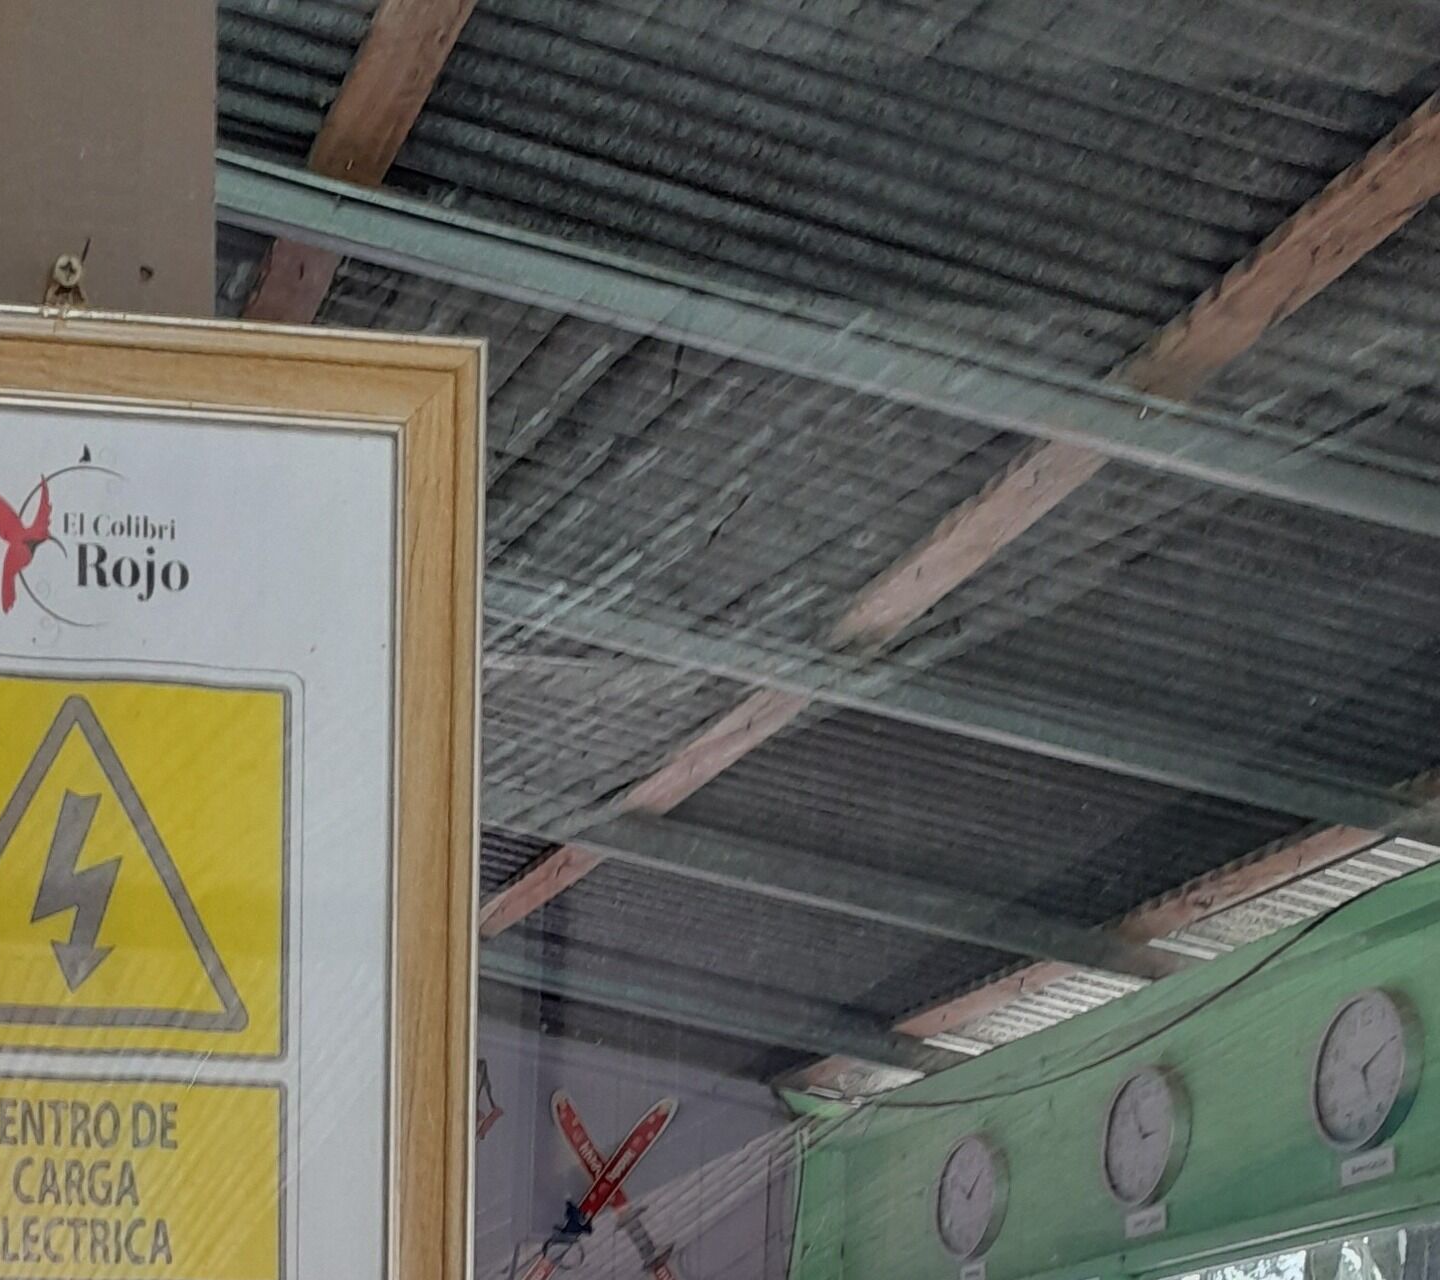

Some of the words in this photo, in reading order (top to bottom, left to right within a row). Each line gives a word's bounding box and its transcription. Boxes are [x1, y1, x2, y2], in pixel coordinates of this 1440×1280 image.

[63, 512, 85, 536] El
[76, 542, 190, 602] Rojo
[132, 1101, 178, 1150] DE
[12, 1156, 140, 1207] CARGA
